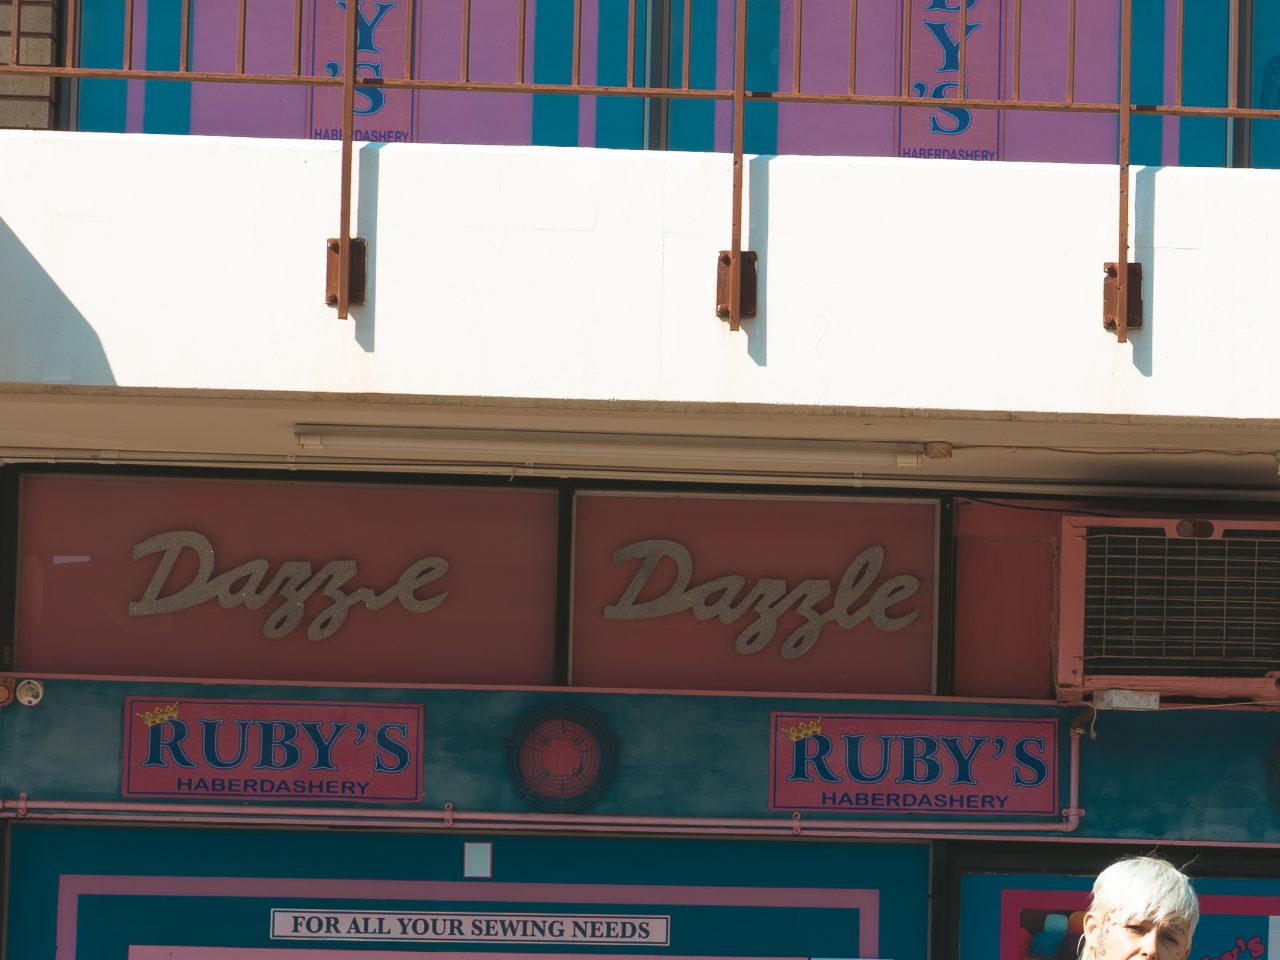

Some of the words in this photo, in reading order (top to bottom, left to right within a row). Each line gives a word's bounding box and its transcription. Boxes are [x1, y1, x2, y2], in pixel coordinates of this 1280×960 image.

[912, 0, 982, 135] Y'S
[314, 128, 410, 142] HABDASHERY
[602, 539, 921, 660] Dazzle
[141, 717, 411, 773] RUBY'S
[786, 733, 1049, 787] RUBY'S
[176, 776, 372, 795] HABERDASHERY
[821, 791, 1009, 809] HABERDASHERY
[291, 915, 343, 935] FOR
[347, 916, 392, 936] ALL
[396, 917, 465, 937] YOUR
[470, 919, 566, 939] SEWING
[571, 920, 650, 939] NEEDS
